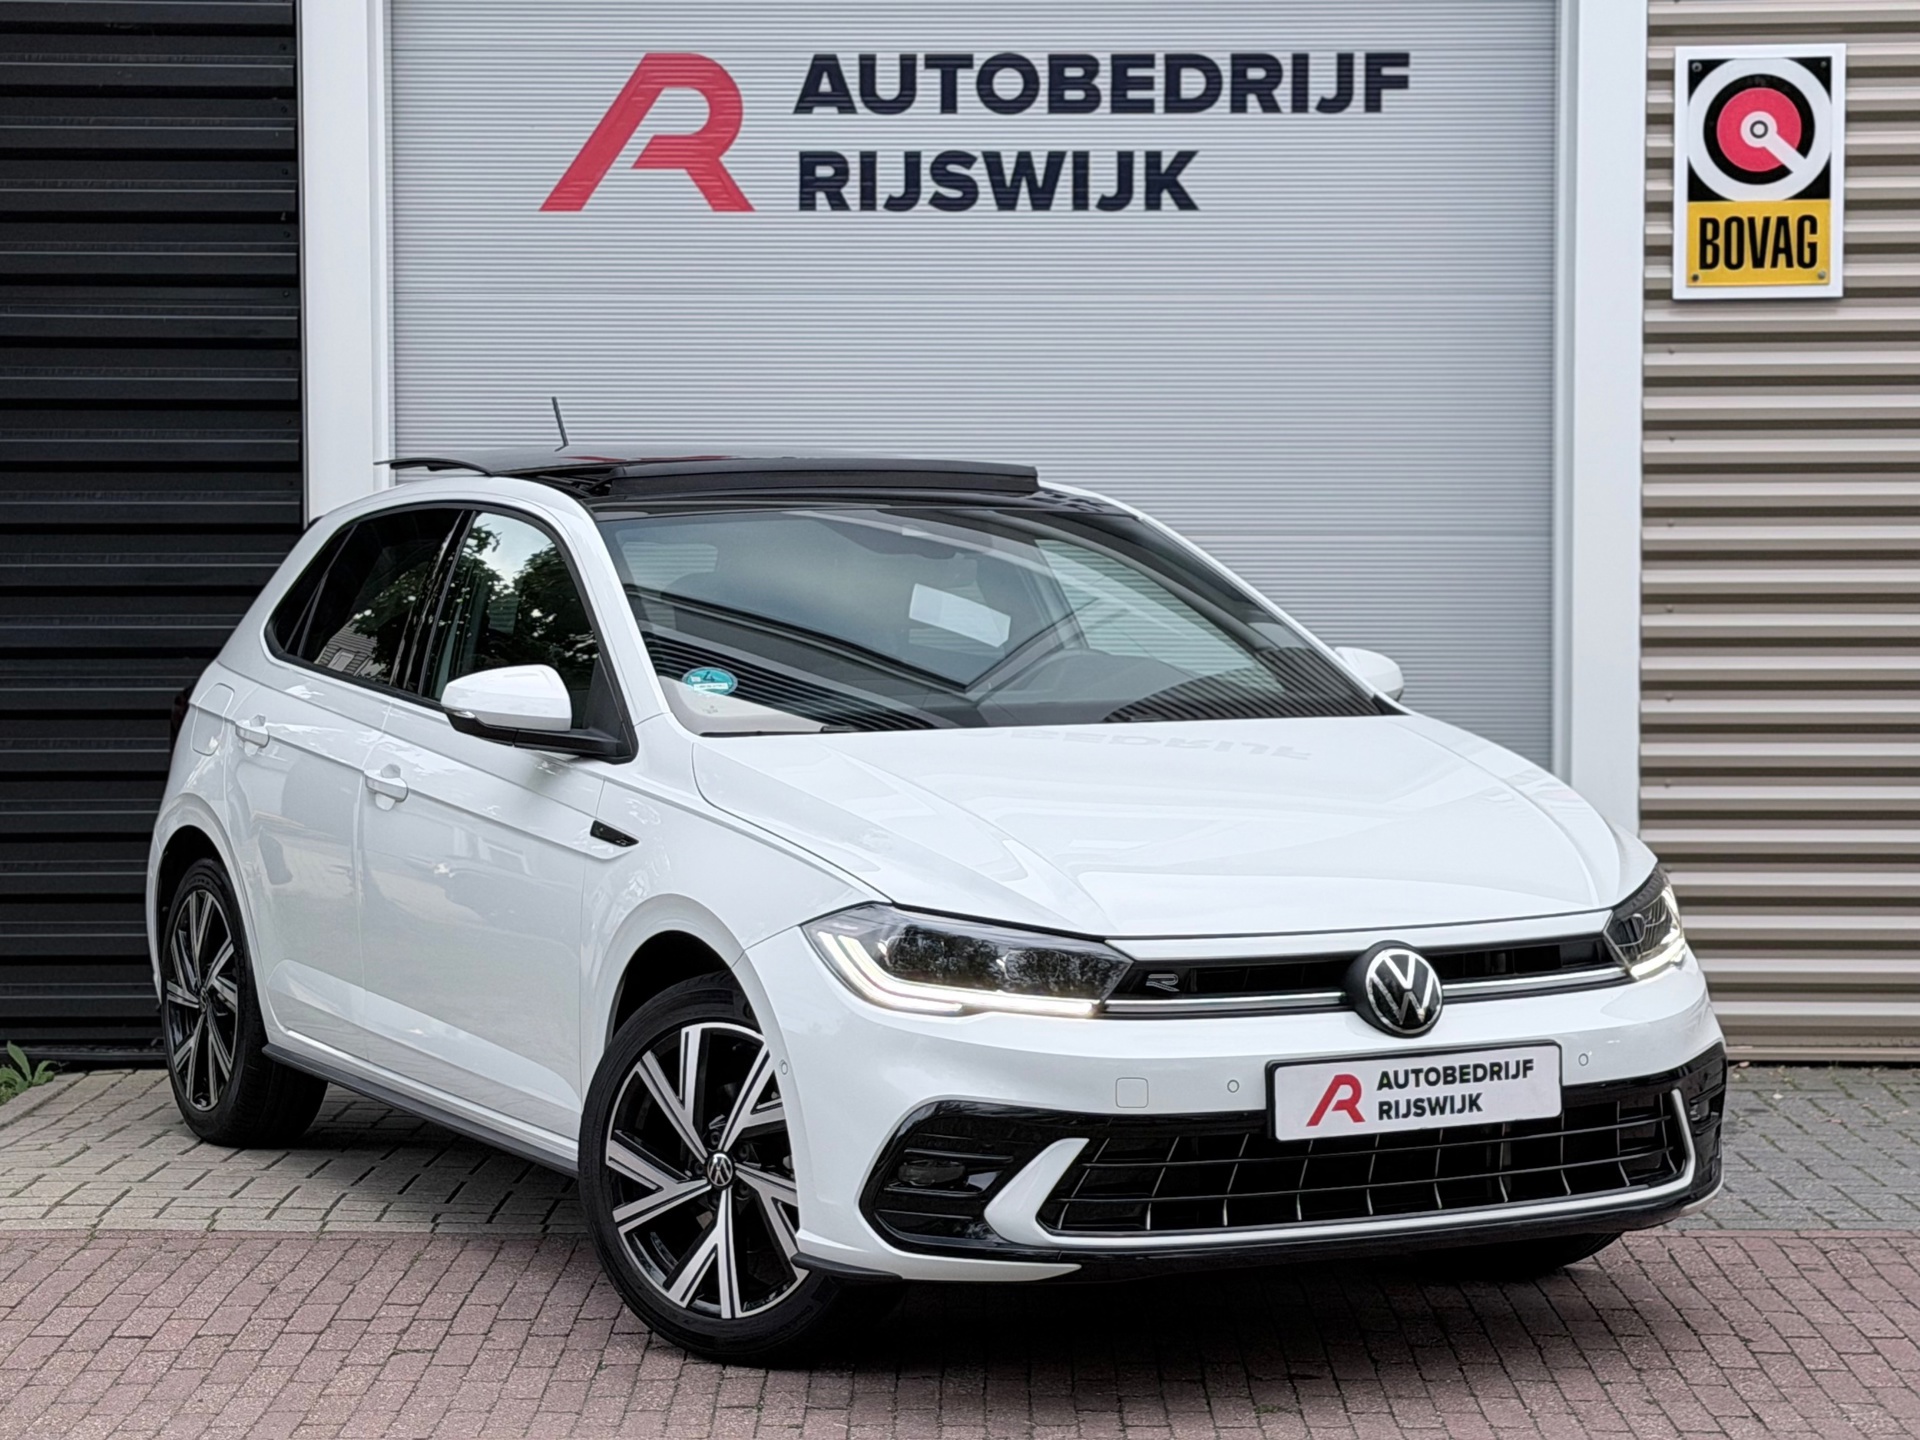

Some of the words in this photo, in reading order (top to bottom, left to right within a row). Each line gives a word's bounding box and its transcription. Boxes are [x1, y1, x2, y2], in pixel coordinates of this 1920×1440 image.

[794, 52, 1411, 115] AUTOBEDRIJF
[799, 150, 1199, 212] RIJSWIJK
[1698, 214, 1818, 270] BOVAG
[1377, 1058, 1534, 1091] AUTOBEDRIJF
[1378, 1093, 1483, 1121] RIJSWIJK
